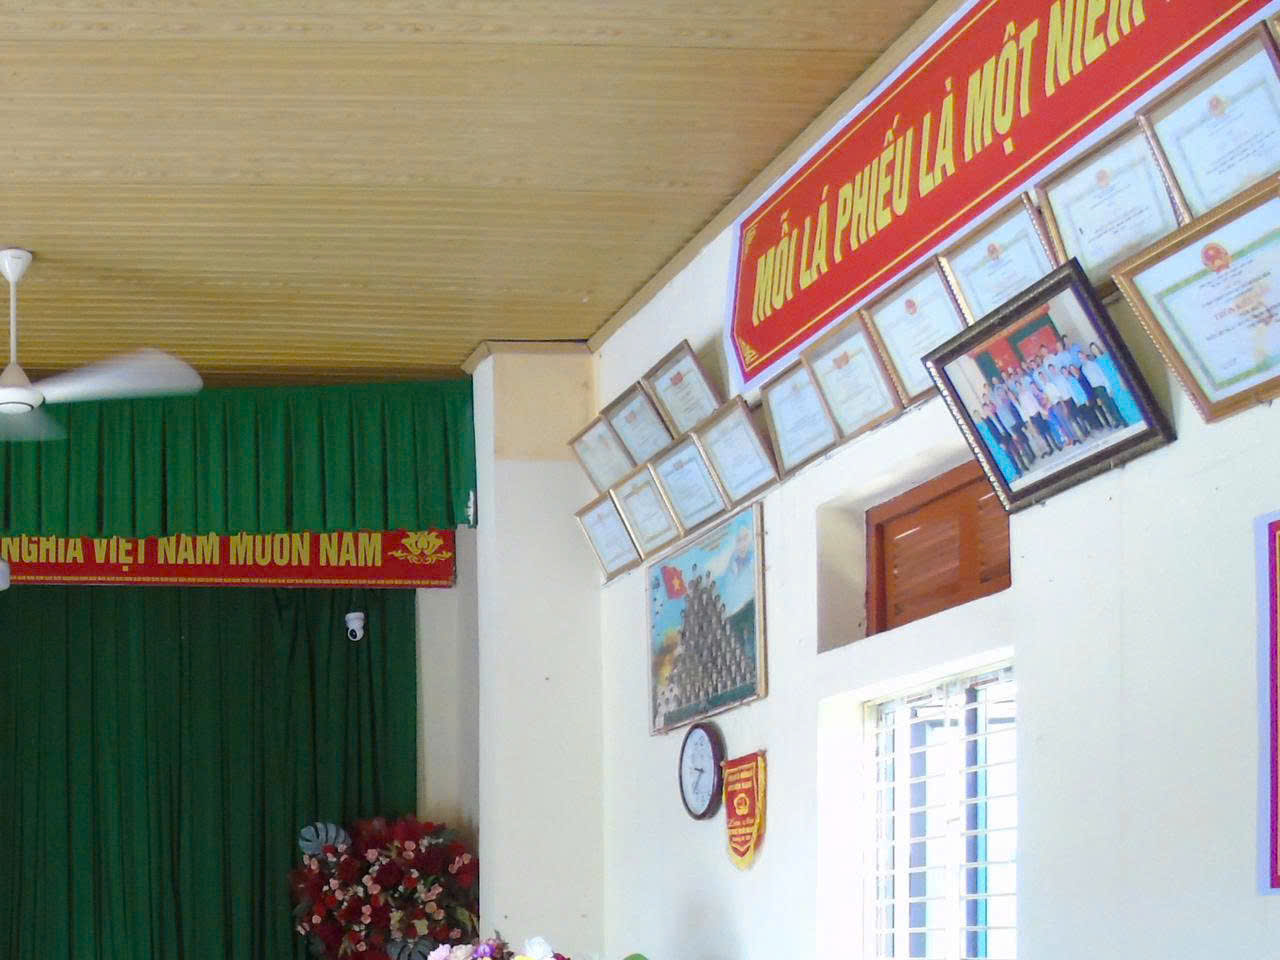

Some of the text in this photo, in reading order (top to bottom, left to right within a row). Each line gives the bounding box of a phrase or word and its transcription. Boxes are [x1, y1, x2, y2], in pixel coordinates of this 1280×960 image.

[752, 209, 798, 327] MỖI
[800, 184, 829, 290] LÁ
[834, 113, 914, 264] PHIẾU
[919, 76, 956, 198] LÀ
[964, 18, 1039, 163] MỘT
[157, 532, 219, 564] NAM
